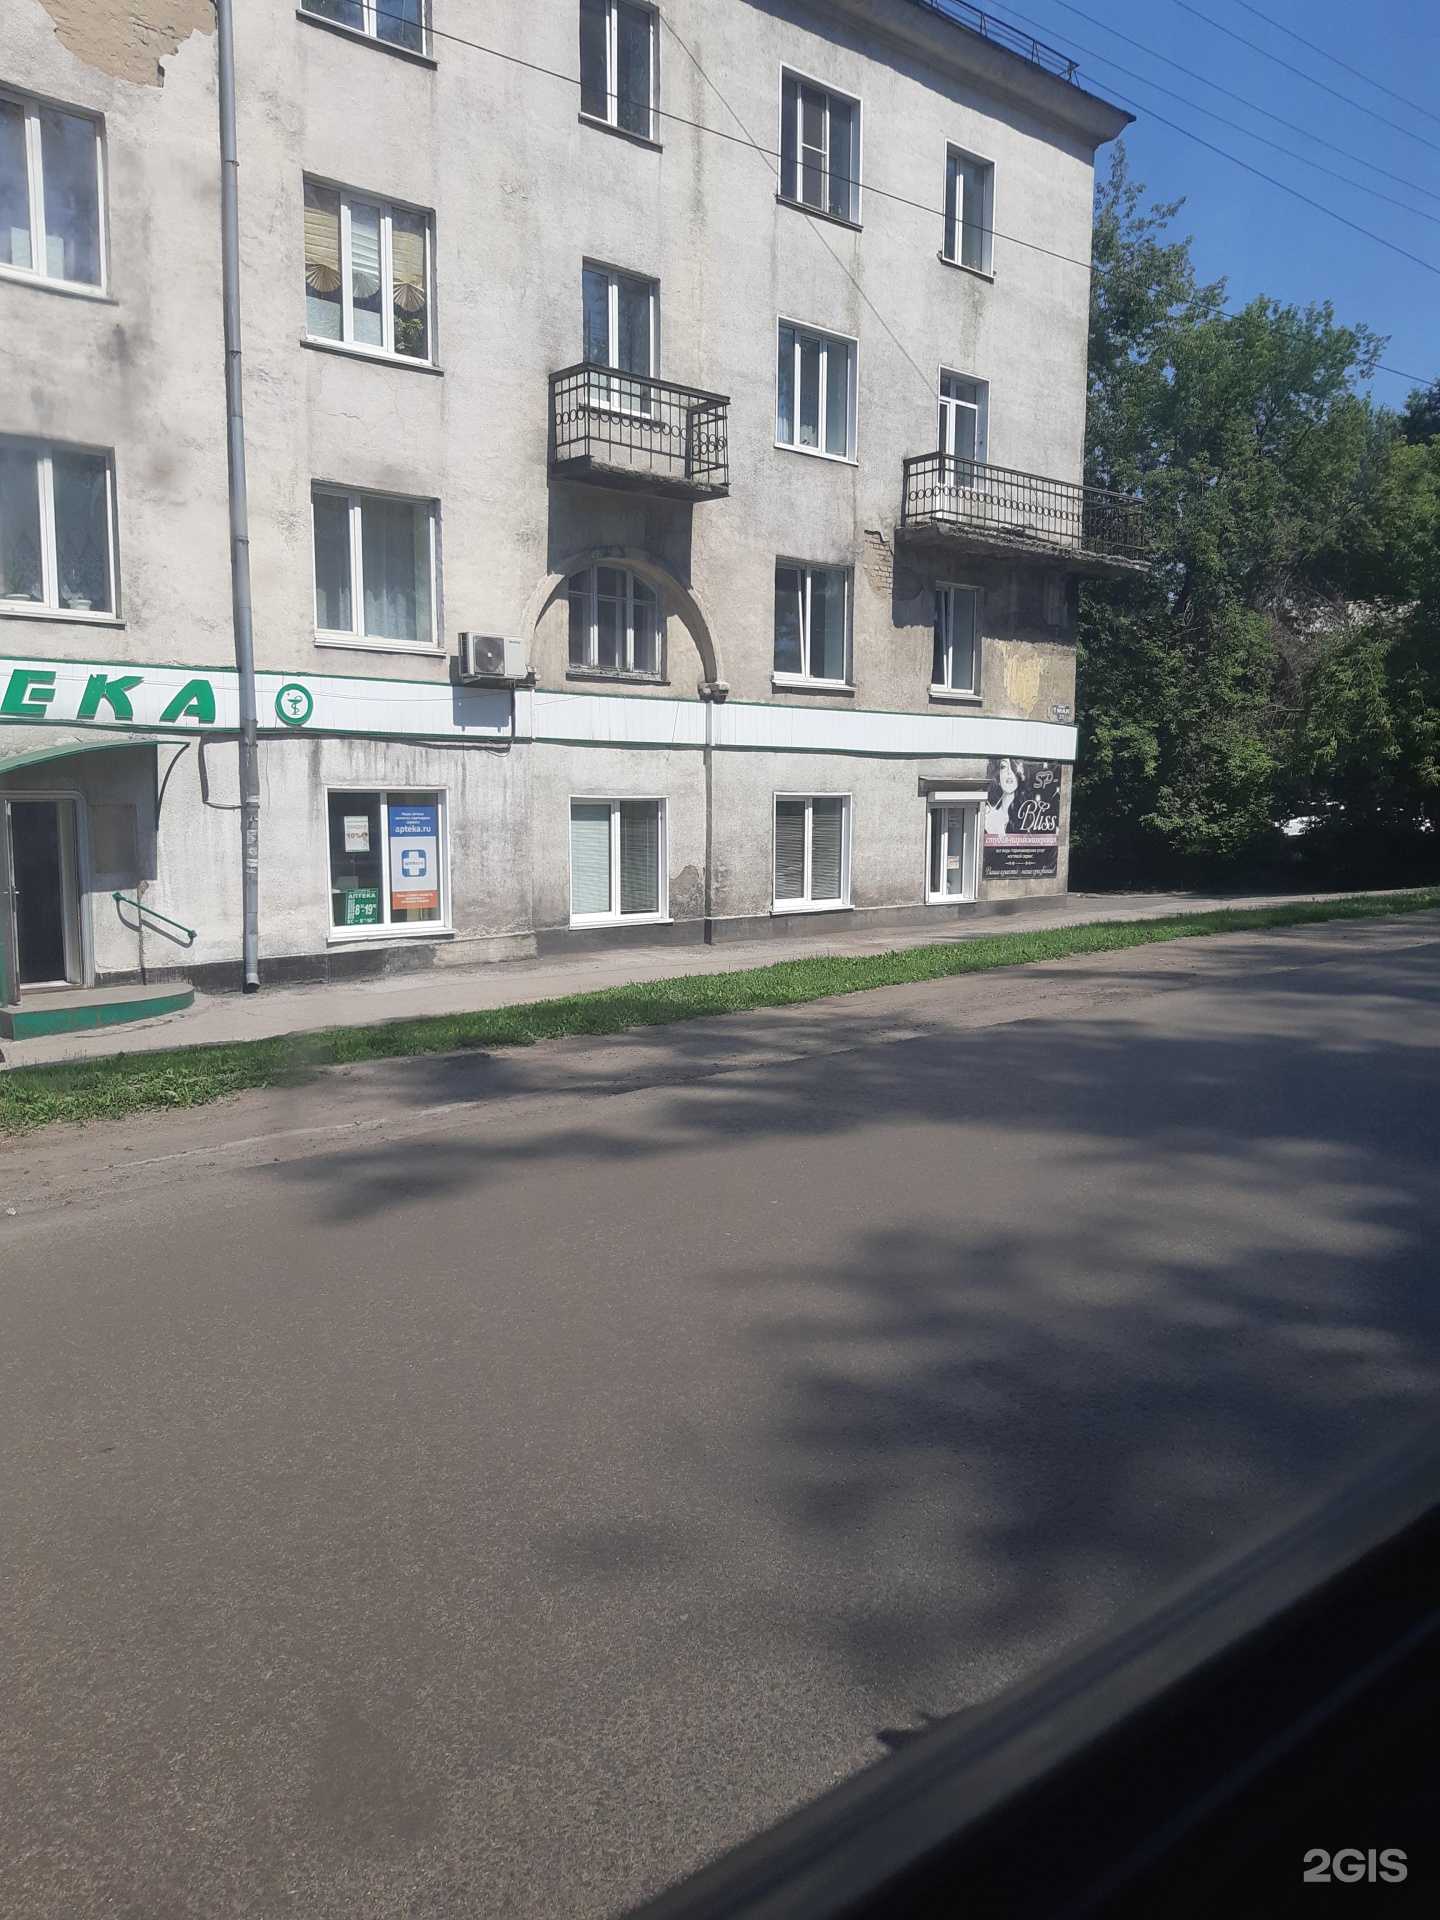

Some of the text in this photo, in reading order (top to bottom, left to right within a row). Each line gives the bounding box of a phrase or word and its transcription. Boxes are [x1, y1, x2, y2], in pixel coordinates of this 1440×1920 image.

[0, 669, 216, 725] ЕКА
[395, 825, 431, 834] apteka.ru
[1017, 799, 1057, 832] Bliss
